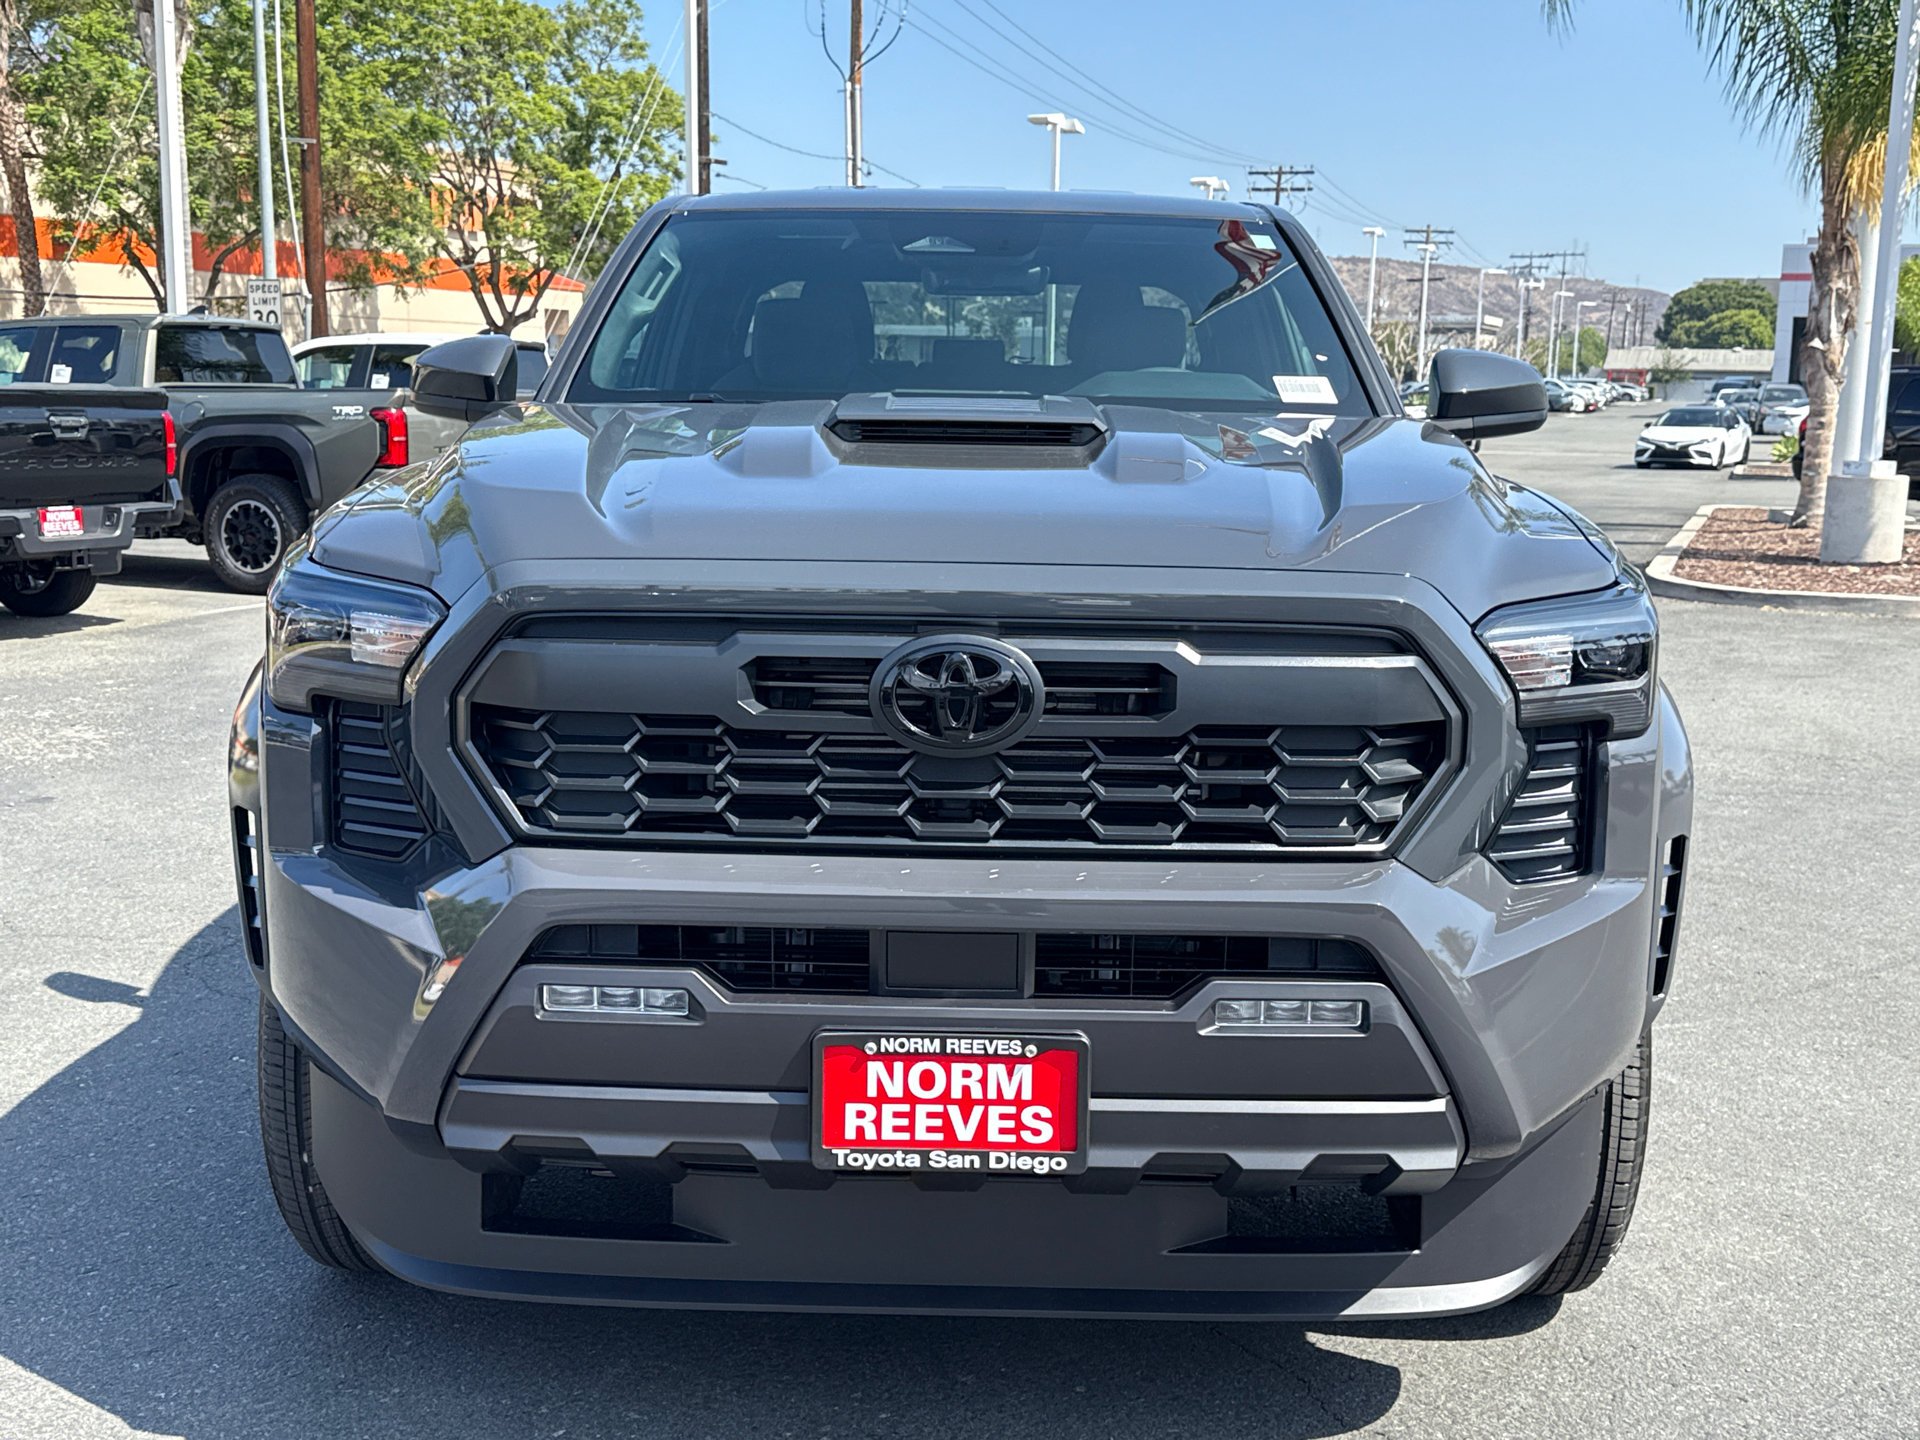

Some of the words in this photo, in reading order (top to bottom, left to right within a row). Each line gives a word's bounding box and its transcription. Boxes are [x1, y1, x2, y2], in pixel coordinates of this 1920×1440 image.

[249, 283, 279, 293] SPEED
[252, 297, 277, 306] LIMIT
[332, 405, 364, 416] TRD
[0, 457, 139, 471] TACOMA
[43, 520, 80, 531] REEVES
[880, 1037, 940, 1054] NORM
[946, 1039, 1022, 1055] REEVES
[866, 1061, 1033, 1101] NORM
[844, 1102, 1054, 1144] REEVES
[832, 1149, 922, 1170] Toyota
[928, 1150, 980, 1169] San
[988, 1151, 1068, 1173] Diego
